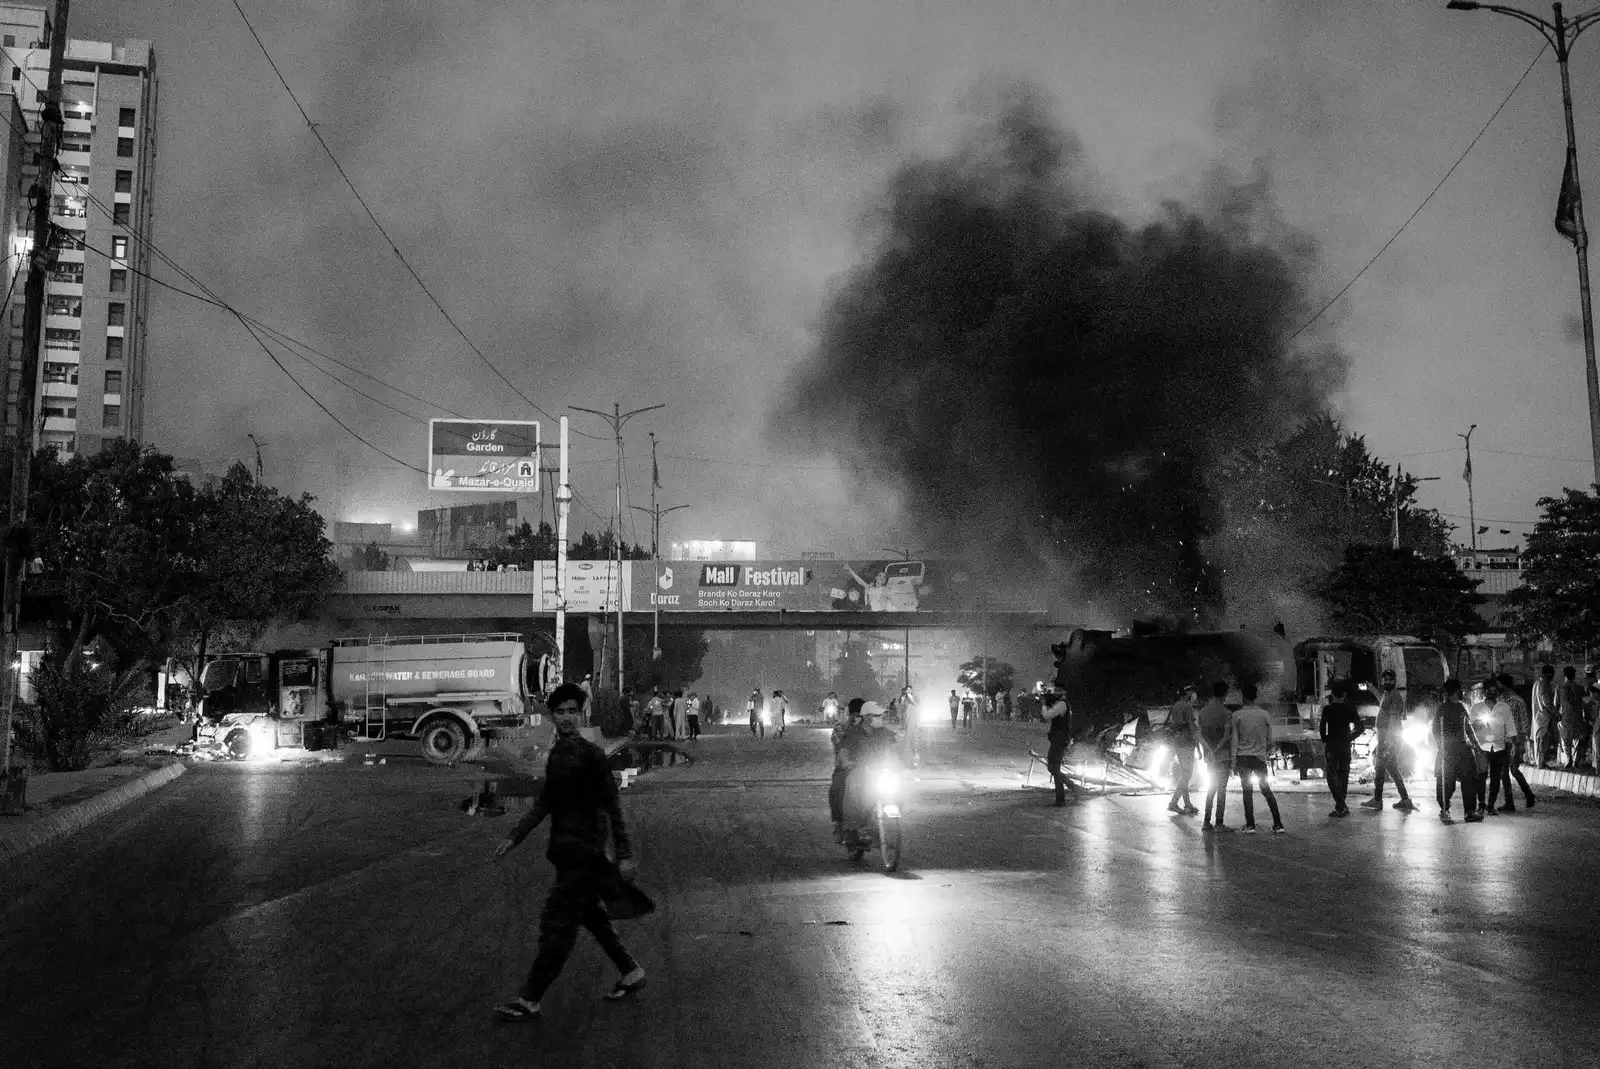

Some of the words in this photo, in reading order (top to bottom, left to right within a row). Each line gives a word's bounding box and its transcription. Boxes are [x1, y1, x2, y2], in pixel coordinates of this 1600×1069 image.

[466, 442, 503, 452] Garden
[705, 566, 734, 584] Mall
[744, 566, 803, 586] Festival
[650, 592, 680, 605] Daraz
[698, 590, 725, 598] Brands
[727, 590, 737, 598] Ko
[739, 590, 760, 598] Daraz
[762, 590, 781, 598] Karo
[698, 599, 717, 607] Soch
[719, 599, 730, 607] Ko
[732, 599, 753, 607] Daraz
[385, 671, 412, 680] WATER
[414, 671, 420, 680] &
[421, 670, 466, 680] SEWERAGE
[467, 669, 496, 678] BOARD
